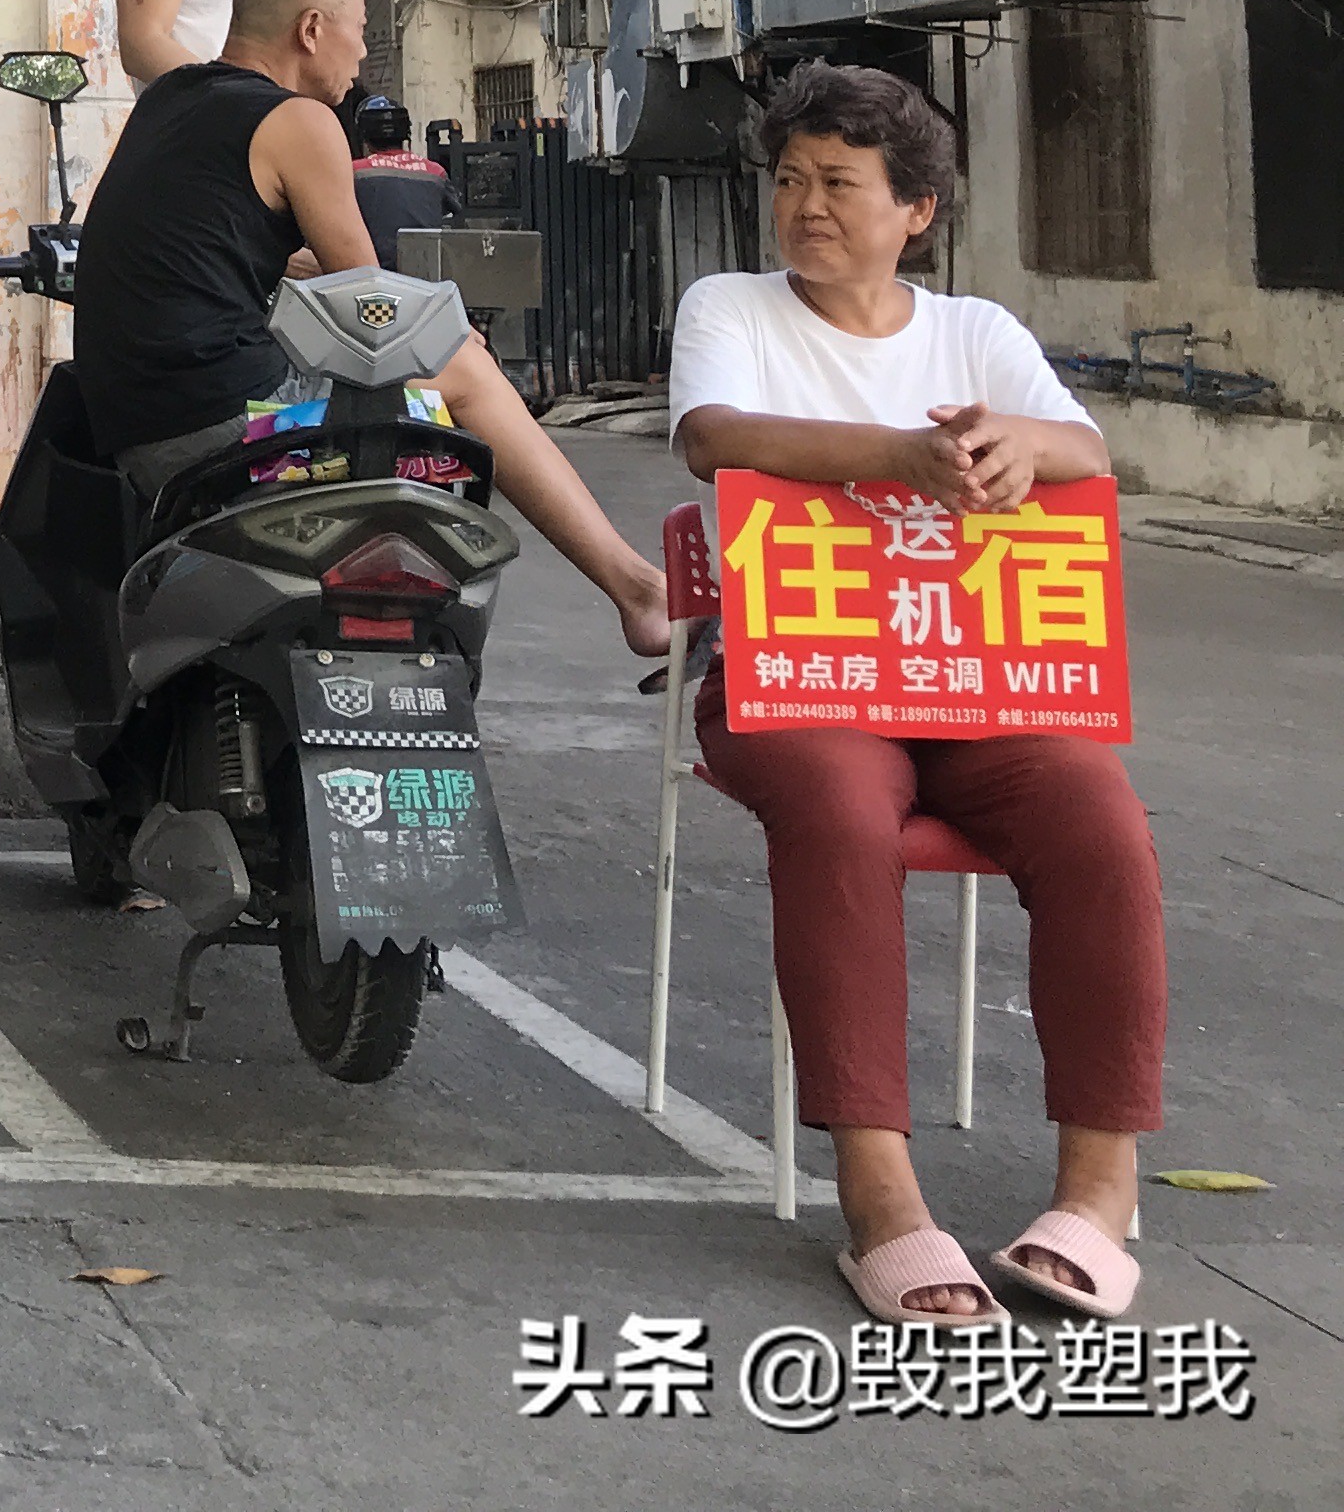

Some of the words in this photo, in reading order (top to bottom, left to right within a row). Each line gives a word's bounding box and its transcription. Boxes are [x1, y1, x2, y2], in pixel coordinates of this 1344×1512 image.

[754, 651, 879, 693] 钟点房
[900, 655, 985, 695] 空调
[1004, 661, 1100, 695] WIFI
[388, 687, 447, 711] 绿源
[386, 768, 477, 811] 绿源
